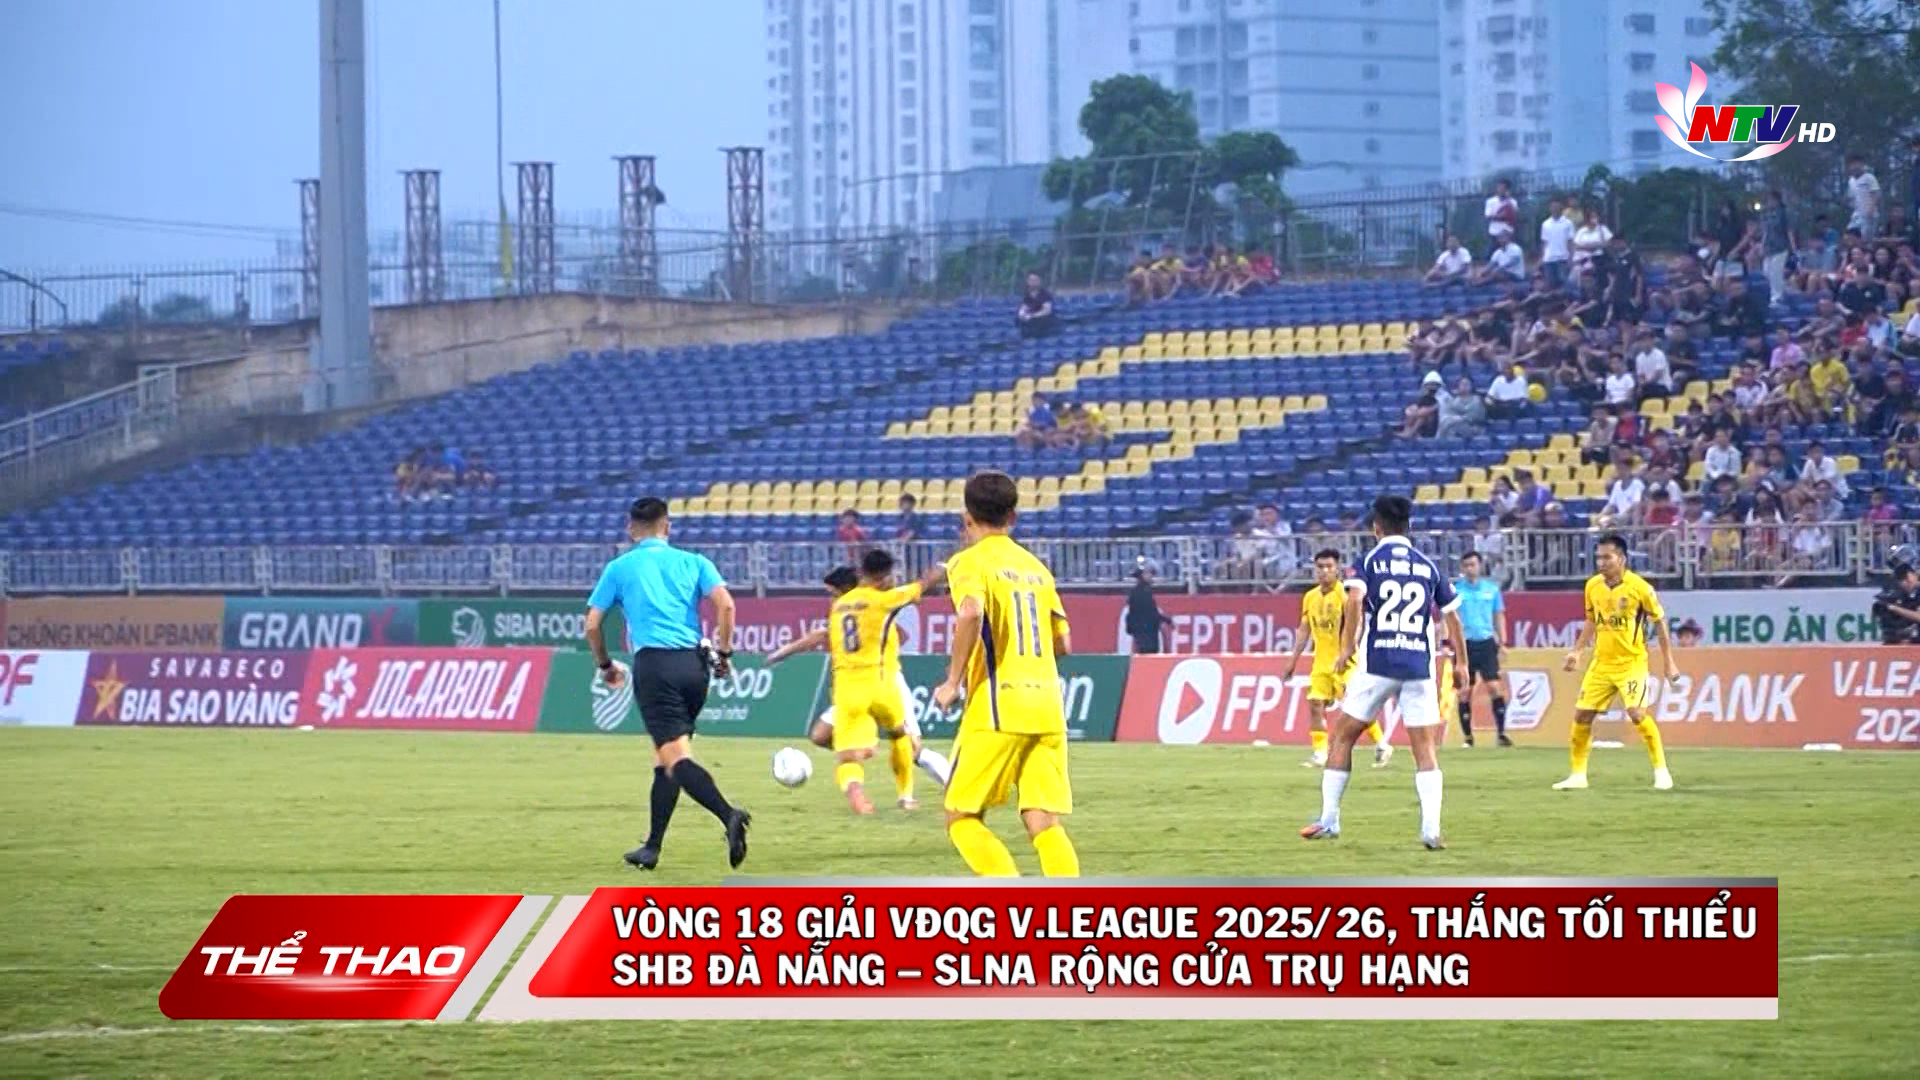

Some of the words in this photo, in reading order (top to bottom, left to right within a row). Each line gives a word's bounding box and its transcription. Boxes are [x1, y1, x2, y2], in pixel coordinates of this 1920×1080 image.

[494, 612, 535, 638] SIBA
[538, 612, 587, 639] FOOD
[1013, 591, 1042, 658] 11
[1377, 580, 1425, 633] 22
[1712, 614, 1775, 643] HEO
[1783, 605, 1826, 642] ĂN
[144, 623, 218, 647] LPBANK
[843, 614, 860, 653] 8
[1171, 614, 1237, 655] FPT
[1243, 613, 1314, 655] Pla
[149, 657, 285, 679] SAVABECO
[120, 688, 162, 723] BIA
[166, 688, 221, 724] SAO
[225, 683, 300, 725] VÀNG
[356, 660, 532, 720] JOGARBOLA
[1221, 675, 1312, 733] FPT
[1597, 673, 1804, 723] BANK
